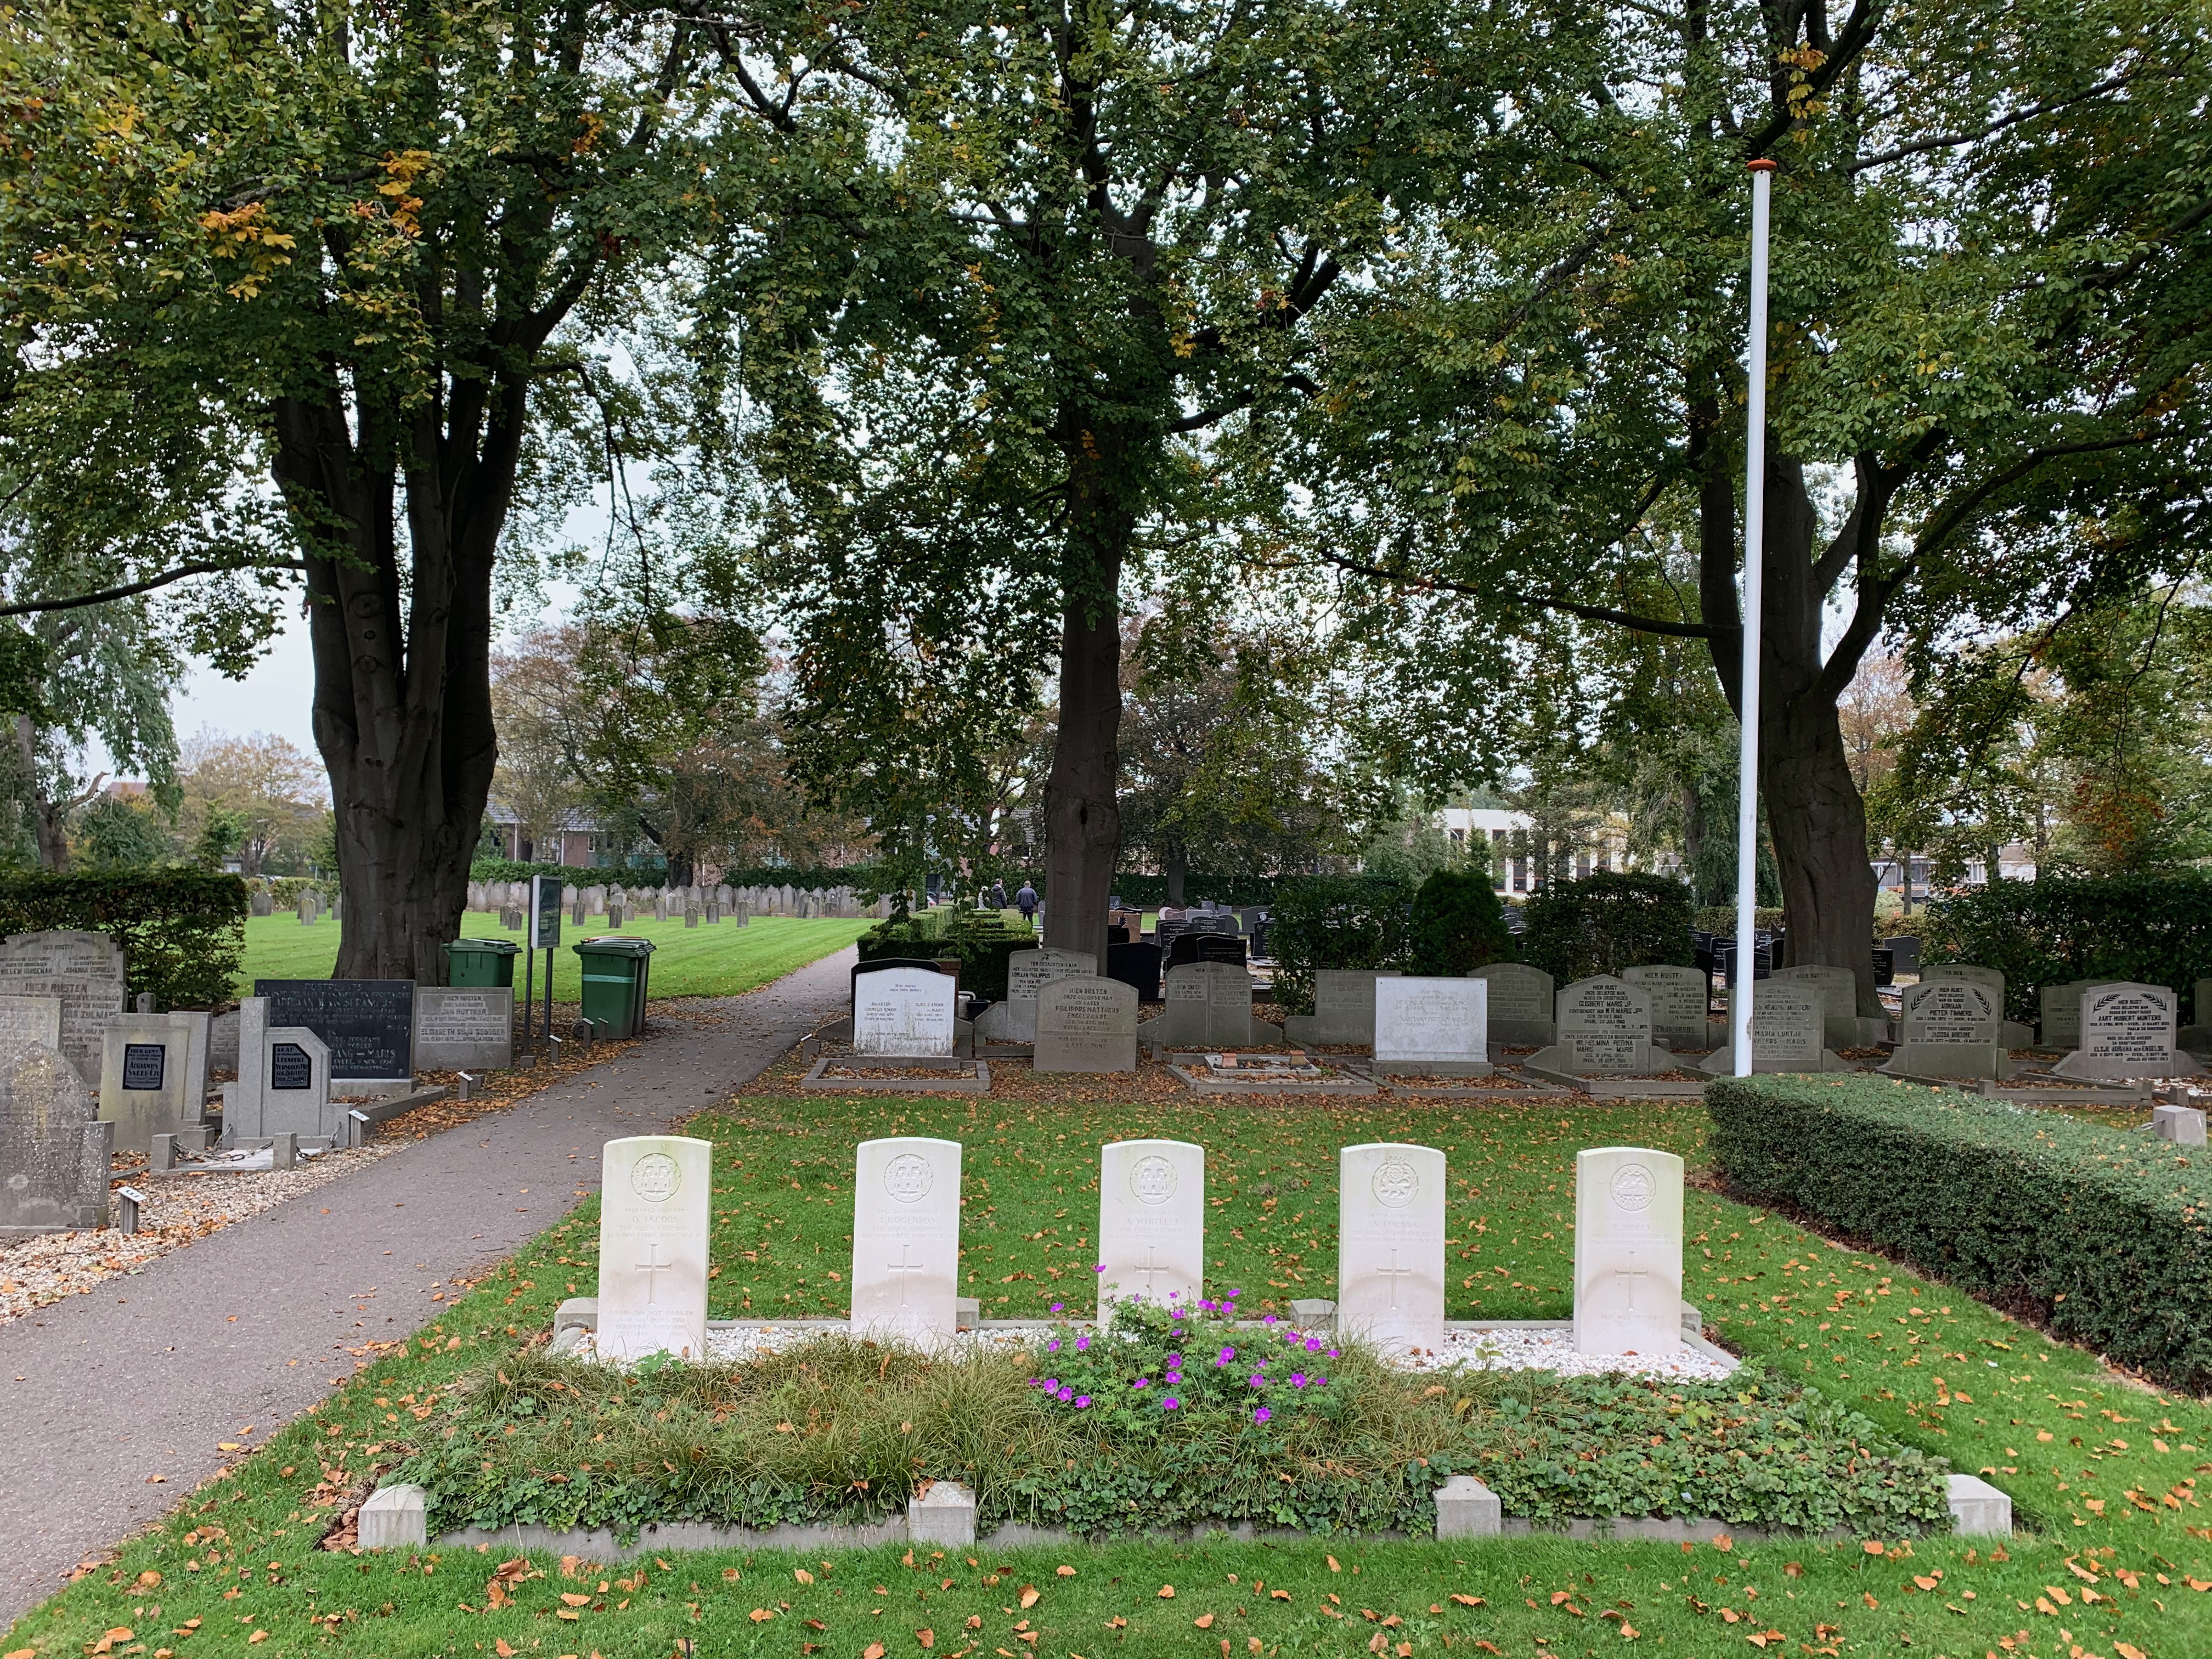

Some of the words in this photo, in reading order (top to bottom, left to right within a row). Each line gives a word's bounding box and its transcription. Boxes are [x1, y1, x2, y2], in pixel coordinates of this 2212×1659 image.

[25, 983, 46, 992] HIER
[50, 984, 88, 993] RUSTEN
[368, 1048, 396, 1058] MARIS
[125, 1190, 140, 1198] E
[1383, 1221, 1418, 1229] FURNISS
[1623, 1224, 1651, 1232] RIDLEY
